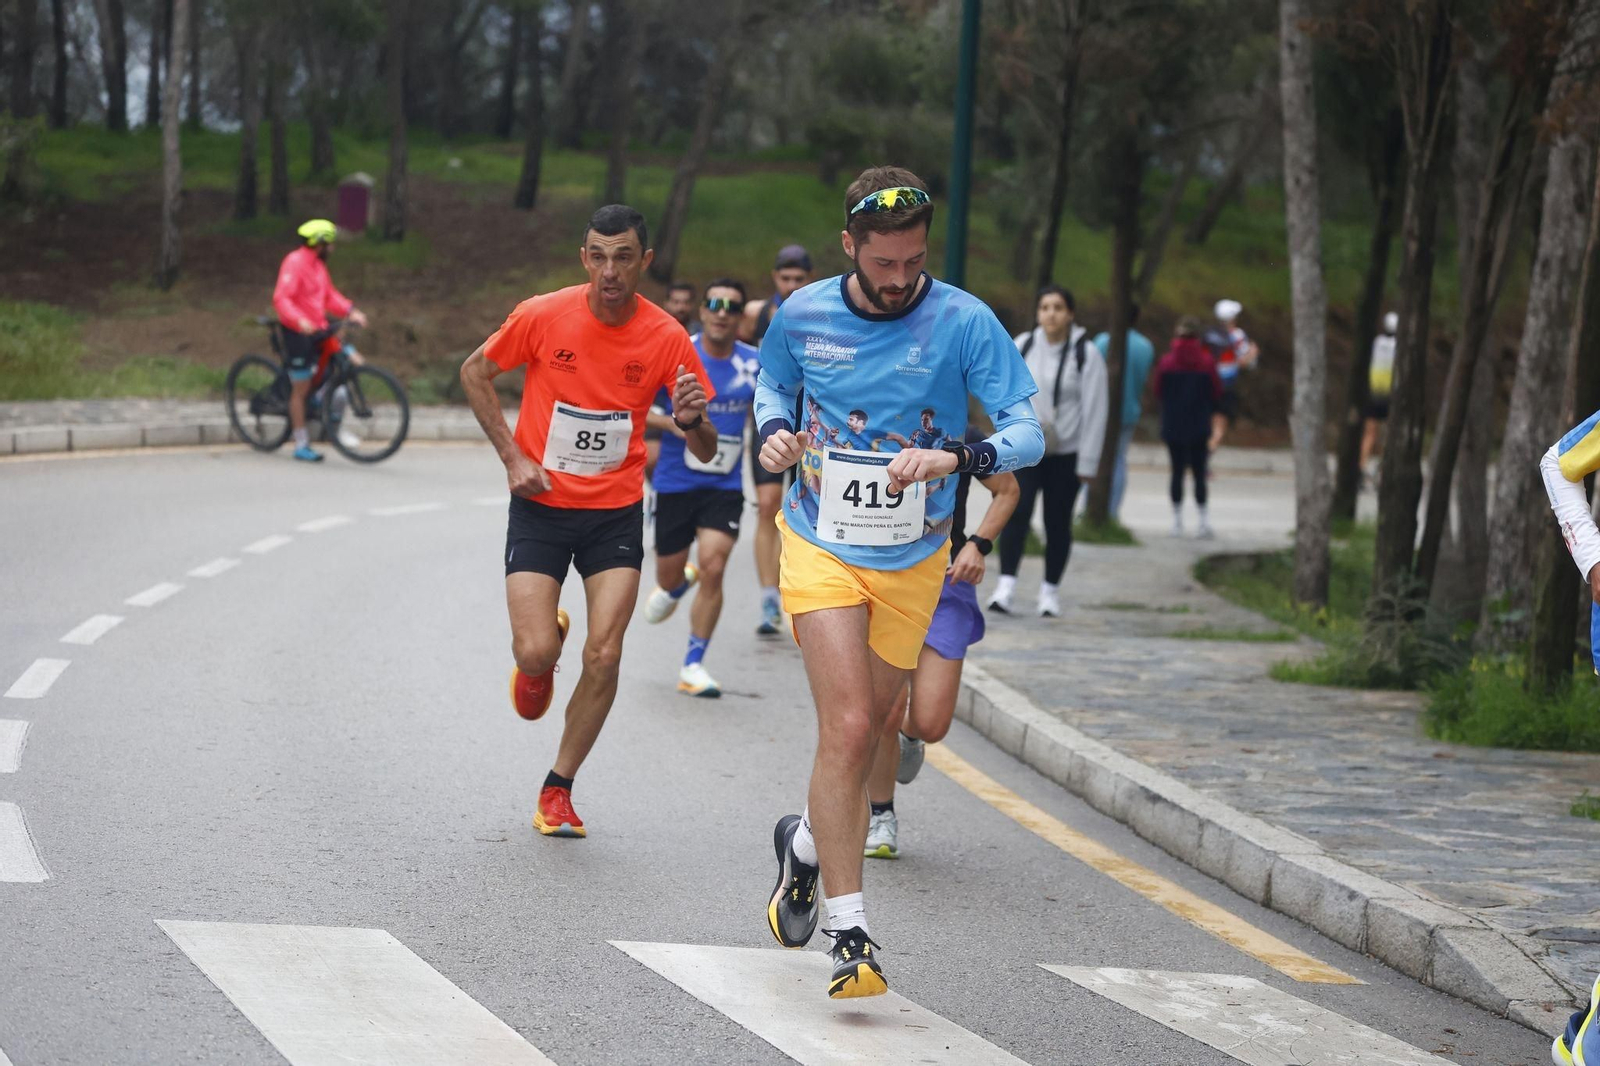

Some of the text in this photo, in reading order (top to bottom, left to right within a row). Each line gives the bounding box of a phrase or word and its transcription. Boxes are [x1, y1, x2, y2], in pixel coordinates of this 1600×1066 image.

[805, 342, 825, 351] MEDIA
[804, 349, 854, 362] INTERNACIONAL
[550, 360, 577, 371] HYUNDAI
[895, 364, 932, 374] Torremolinos
[575, 430, 606, 450] 85
[842, 480, 904, 508] 419
